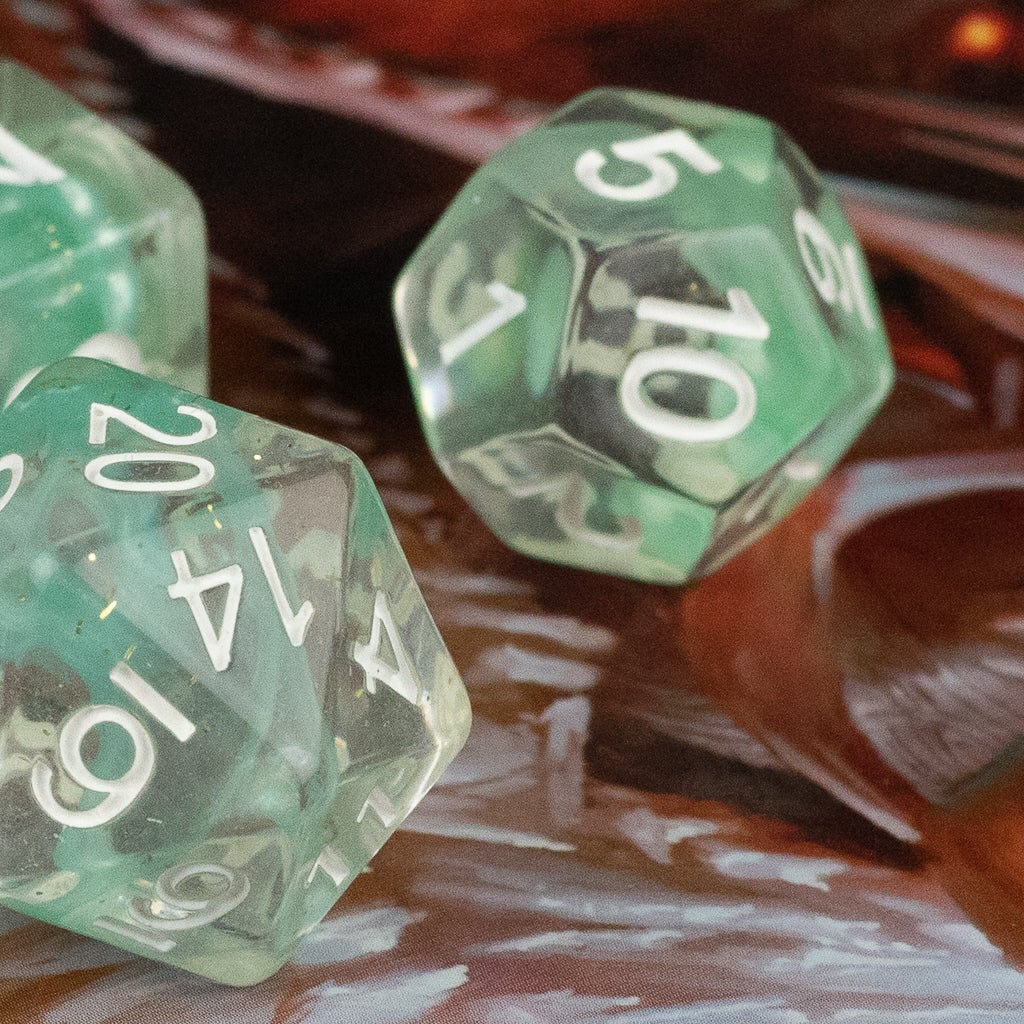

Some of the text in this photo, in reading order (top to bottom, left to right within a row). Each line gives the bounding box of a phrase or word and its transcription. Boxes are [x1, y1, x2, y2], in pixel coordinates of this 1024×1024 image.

[575, 128, 723, 201] 5
[440, 281, 527, 365] 1
[620, 287, 771, 442] 10
[84, 402, 217, 493] 20
[168, 526, 314, 673] 14
[353, 590, 429, 709] 4
